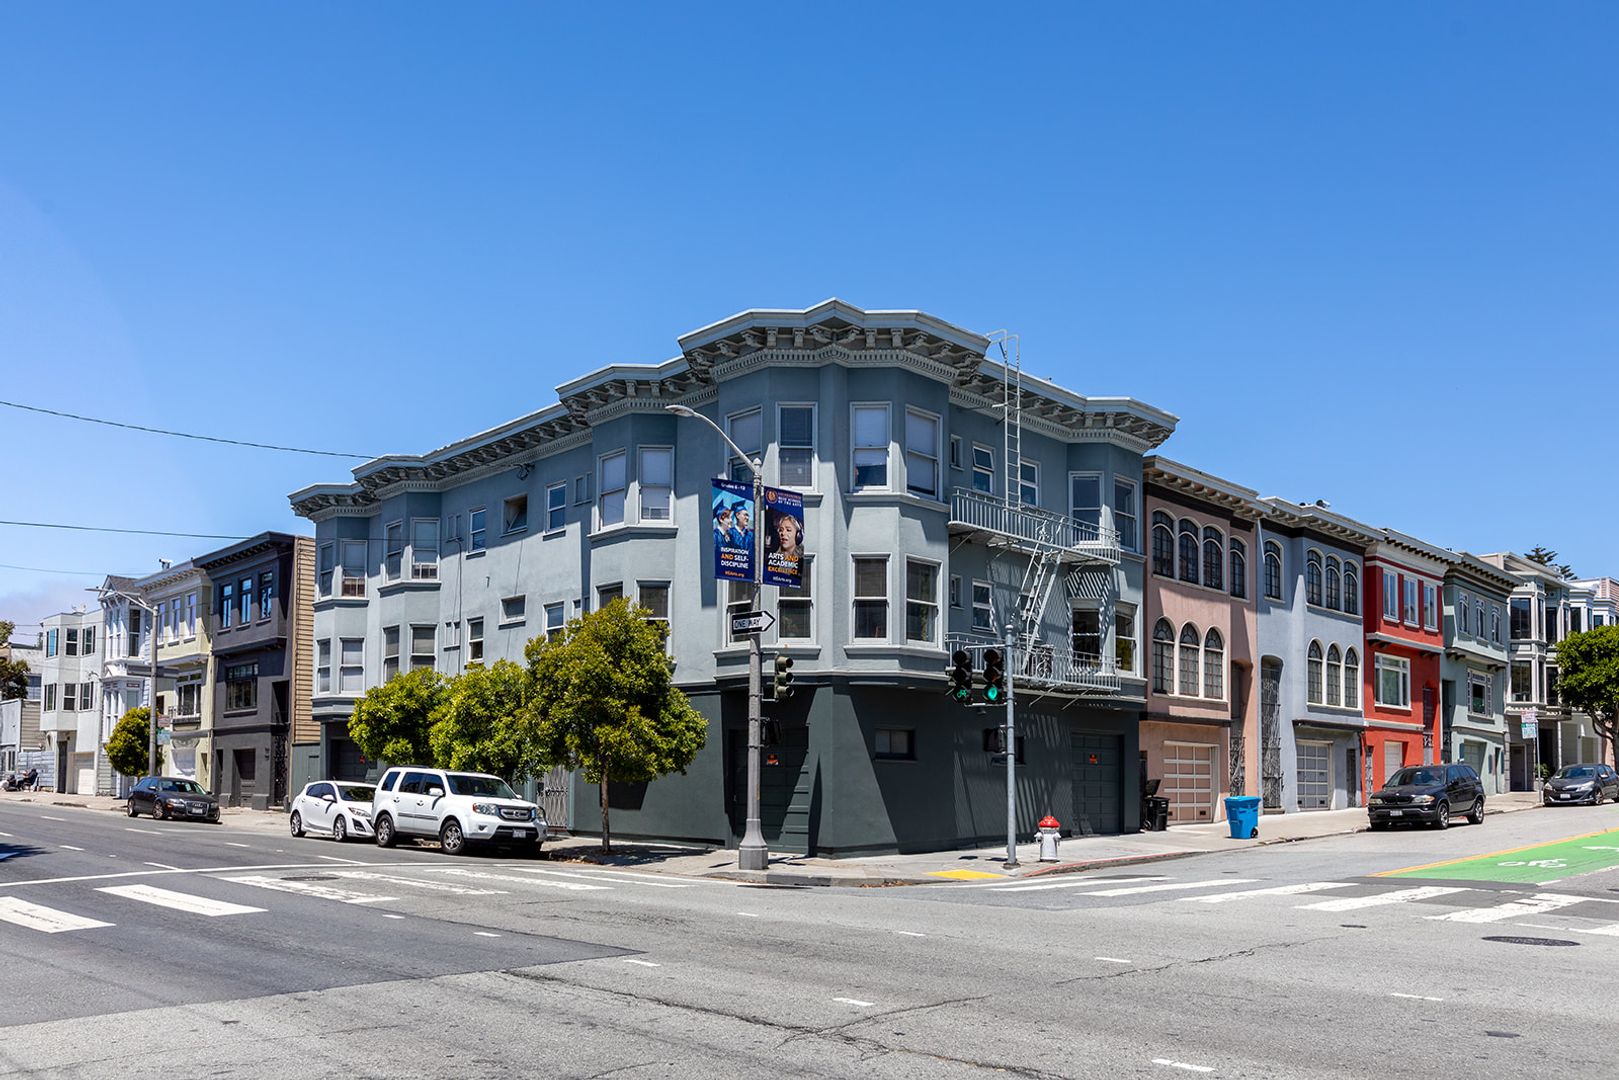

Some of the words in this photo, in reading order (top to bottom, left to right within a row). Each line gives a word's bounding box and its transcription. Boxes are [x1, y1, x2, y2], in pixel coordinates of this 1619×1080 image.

[721, 546, 749, 555] INSPIRATION
[768, 552, 784, 560] ARTS
[784, 554, 799, 562] AND
[721, 560, 749, 569] DISCIPLINE
[768, 560, 799, 569] ACADEMIC
[768, 566, 798, 575] EXCELLENCE
[735, 620, 748, 629] ONE
[748, 618, 761, 628] WAY
